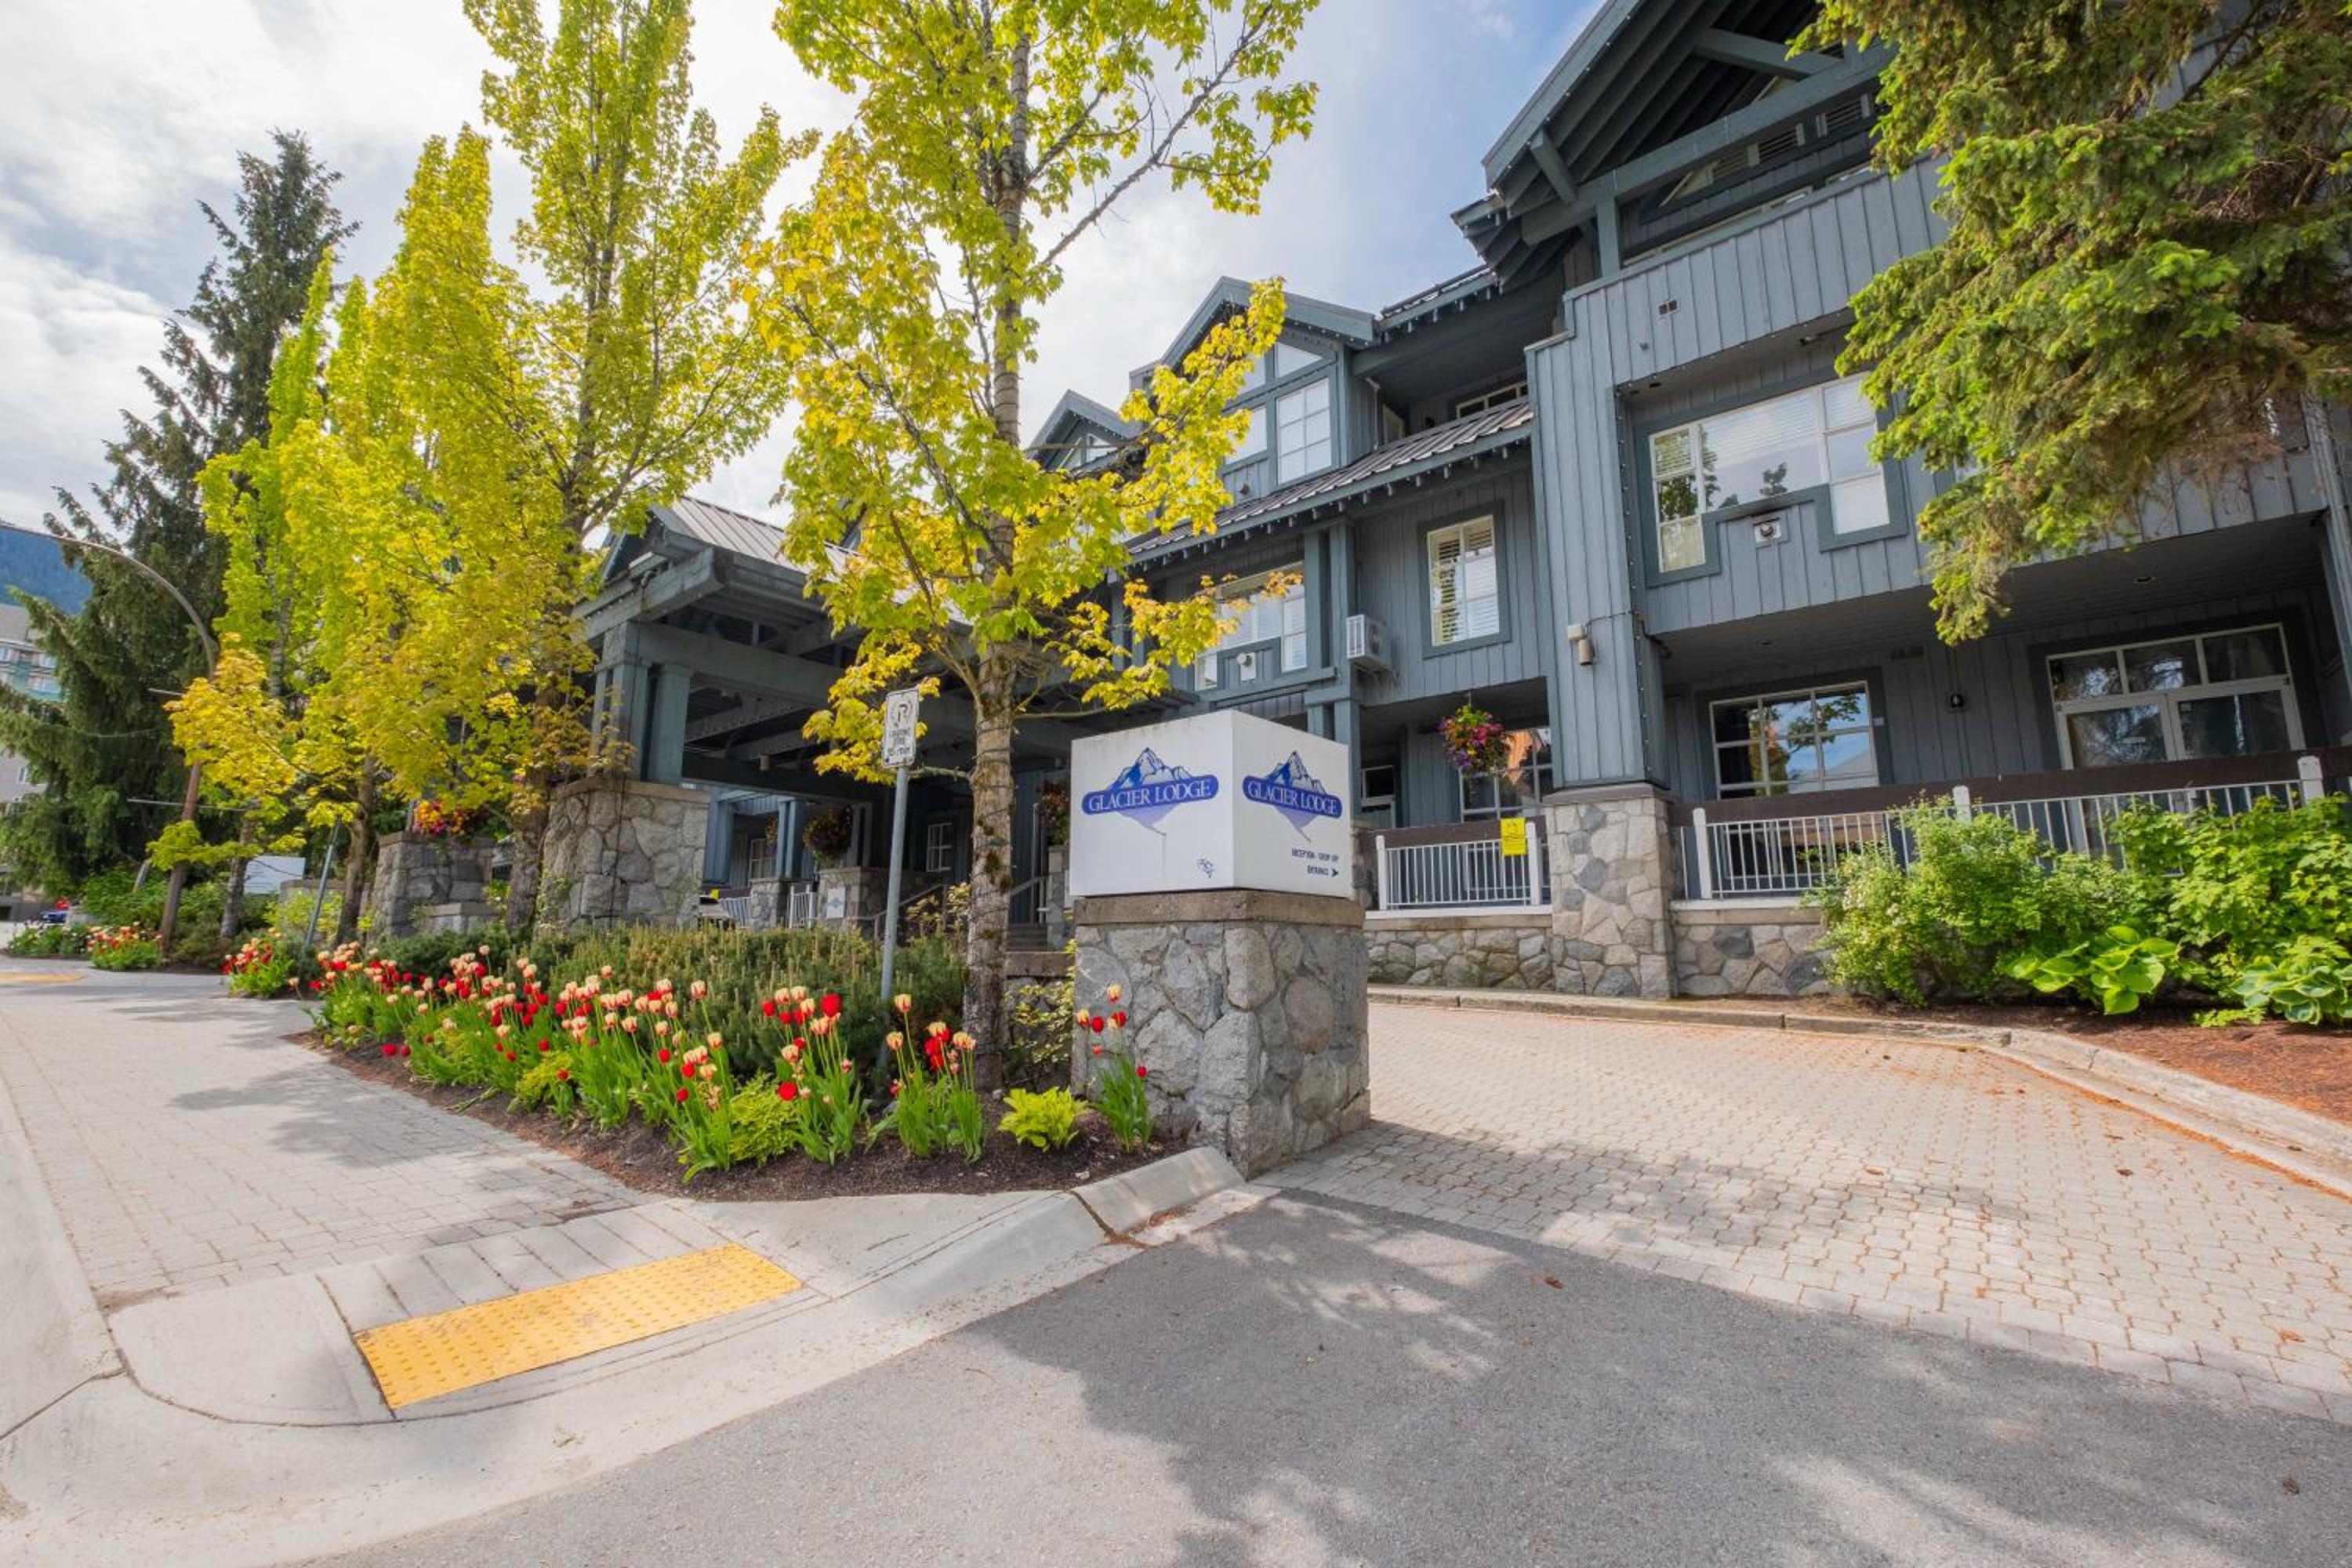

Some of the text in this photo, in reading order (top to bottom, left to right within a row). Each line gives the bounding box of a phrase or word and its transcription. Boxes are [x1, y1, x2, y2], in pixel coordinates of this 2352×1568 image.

[1089, 779, 1211, 812] GLACIER LODGE
[1247, 780, 1339, 815] GLACIER LODGE
